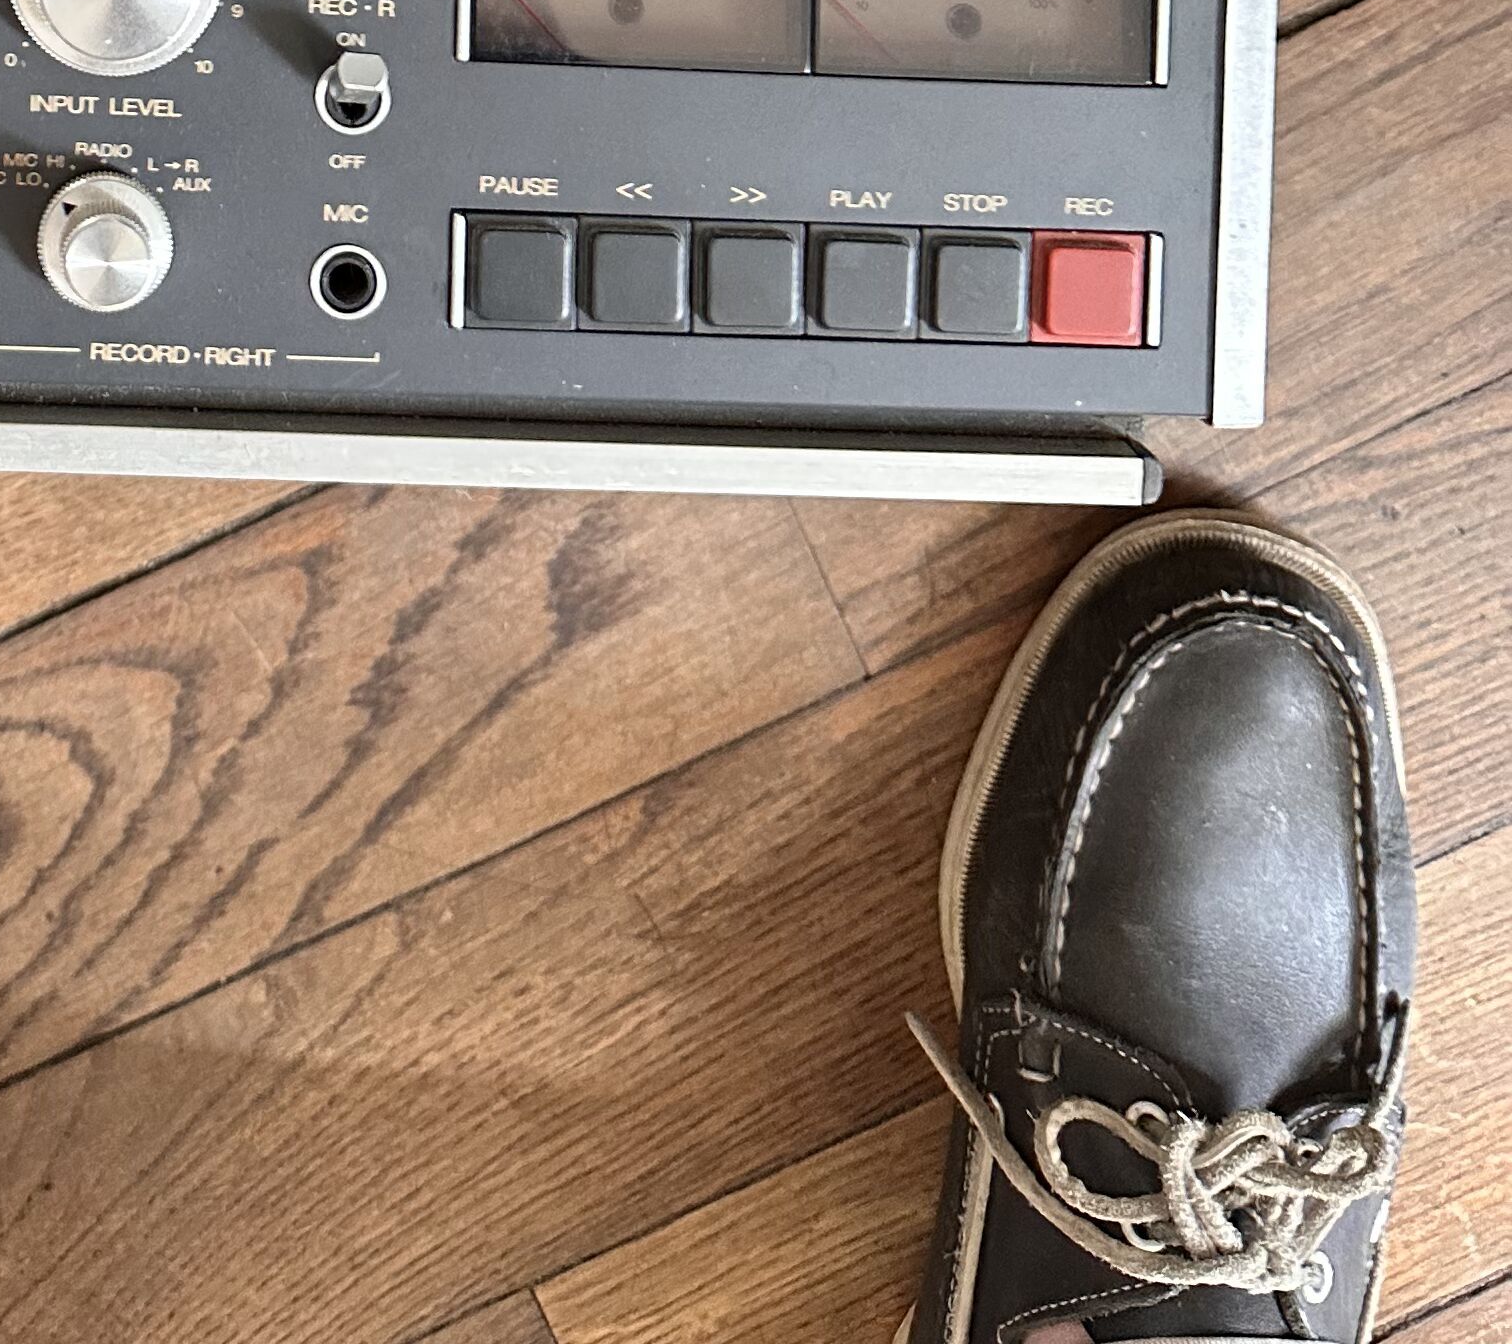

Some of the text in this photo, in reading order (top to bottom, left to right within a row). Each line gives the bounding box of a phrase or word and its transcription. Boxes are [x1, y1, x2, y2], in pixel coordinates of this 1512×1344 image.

[230, 4, 244, 18] 9
[336, 32, 366, 48] ON
[4, 52, 18, 67] 0
[194, 59, 214, 74] 10
[29, 94, 183, 118] INPUT LEVEL
[74, 141, 133, 159] RADIO
[3, 152, 65, 168] MIC HI
[328, 154, 367, 169] OFF
[15, 171, 42, 186] LO
[172, 177, 212, 192] AUX
[479, 175, 559, 196] PAUSE
[829, 189, 893, 209] PLAY
[943, 193, 1009, 213] STOP
[1064, 197, 1115, 217] REC
[323, 203, 369, 224] MIC
[89, 342, 277, 367] RECORD RIGHT
